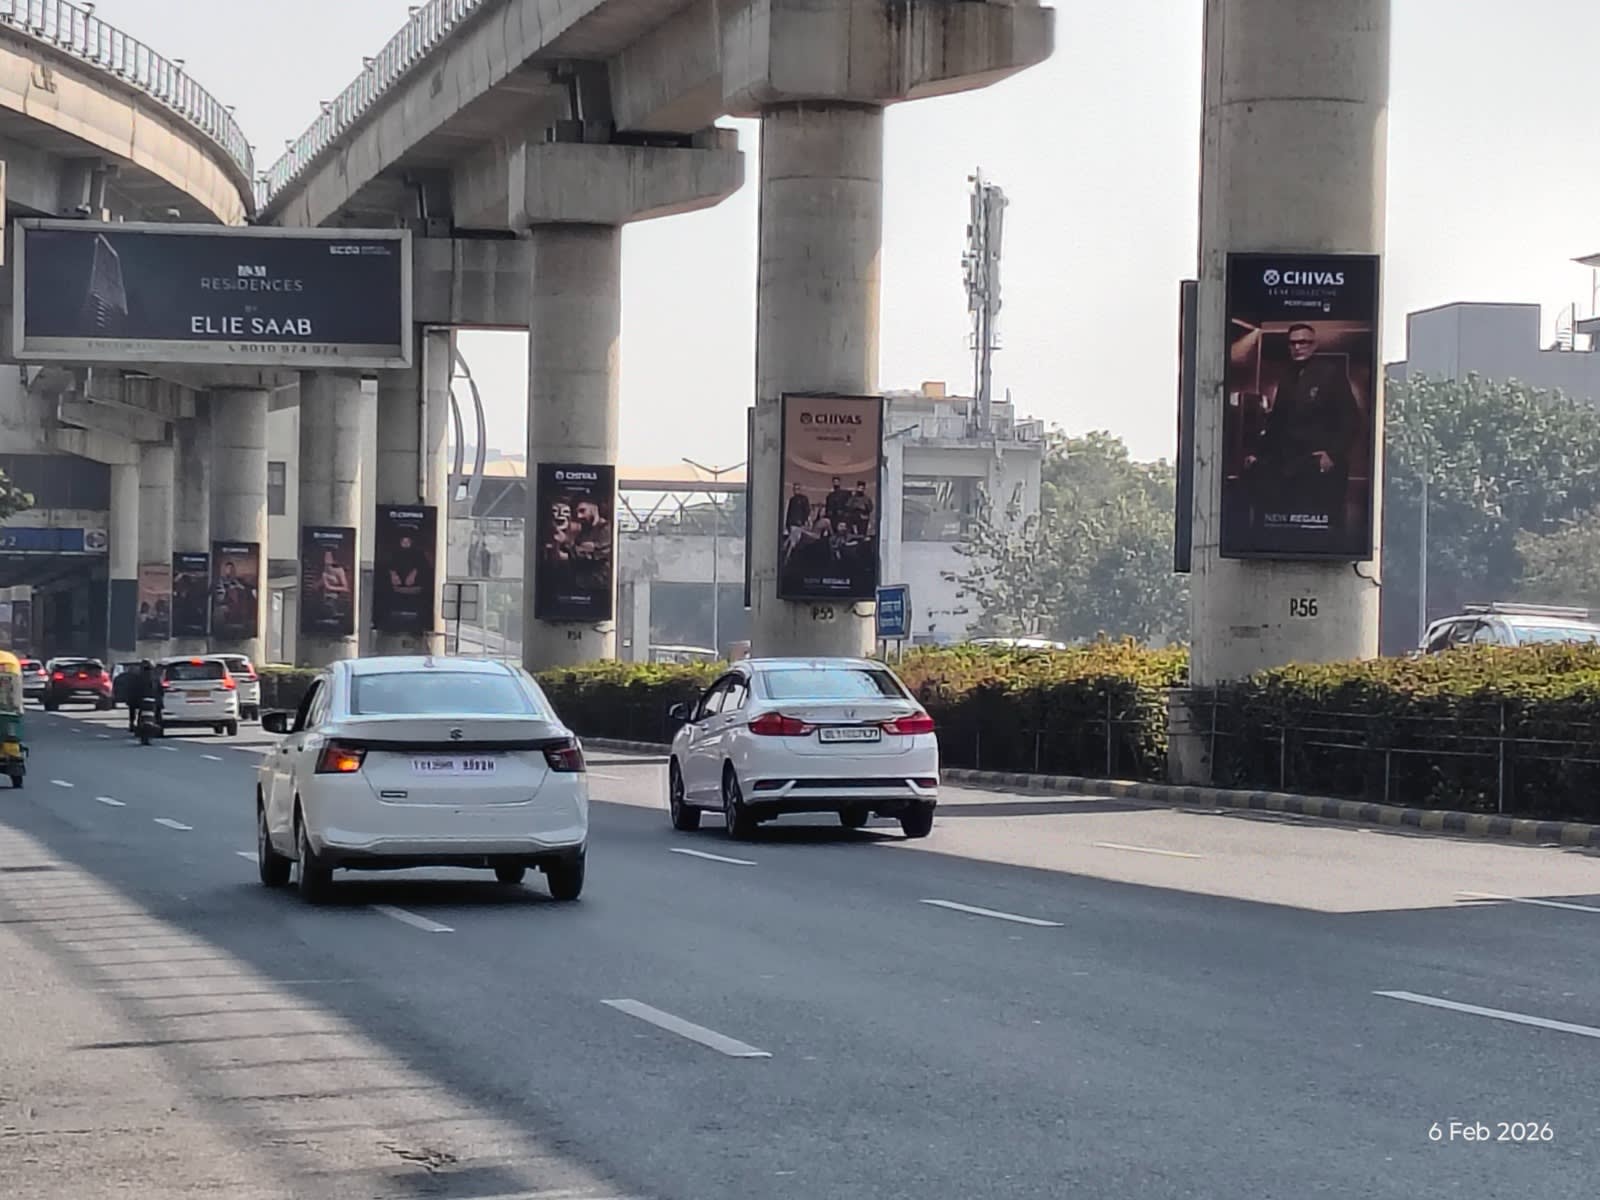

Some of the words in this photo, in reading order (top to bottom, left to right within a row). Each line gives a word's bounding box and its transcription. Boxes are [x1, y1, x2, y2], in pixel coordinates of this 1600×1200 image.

[1283, 271, 1345, 285] CHIVAS
[191, 316, 244, 334] ELIE
[251, 317, 312, 335] SAAB
[815, 412, 862, 425] CHIVAS
